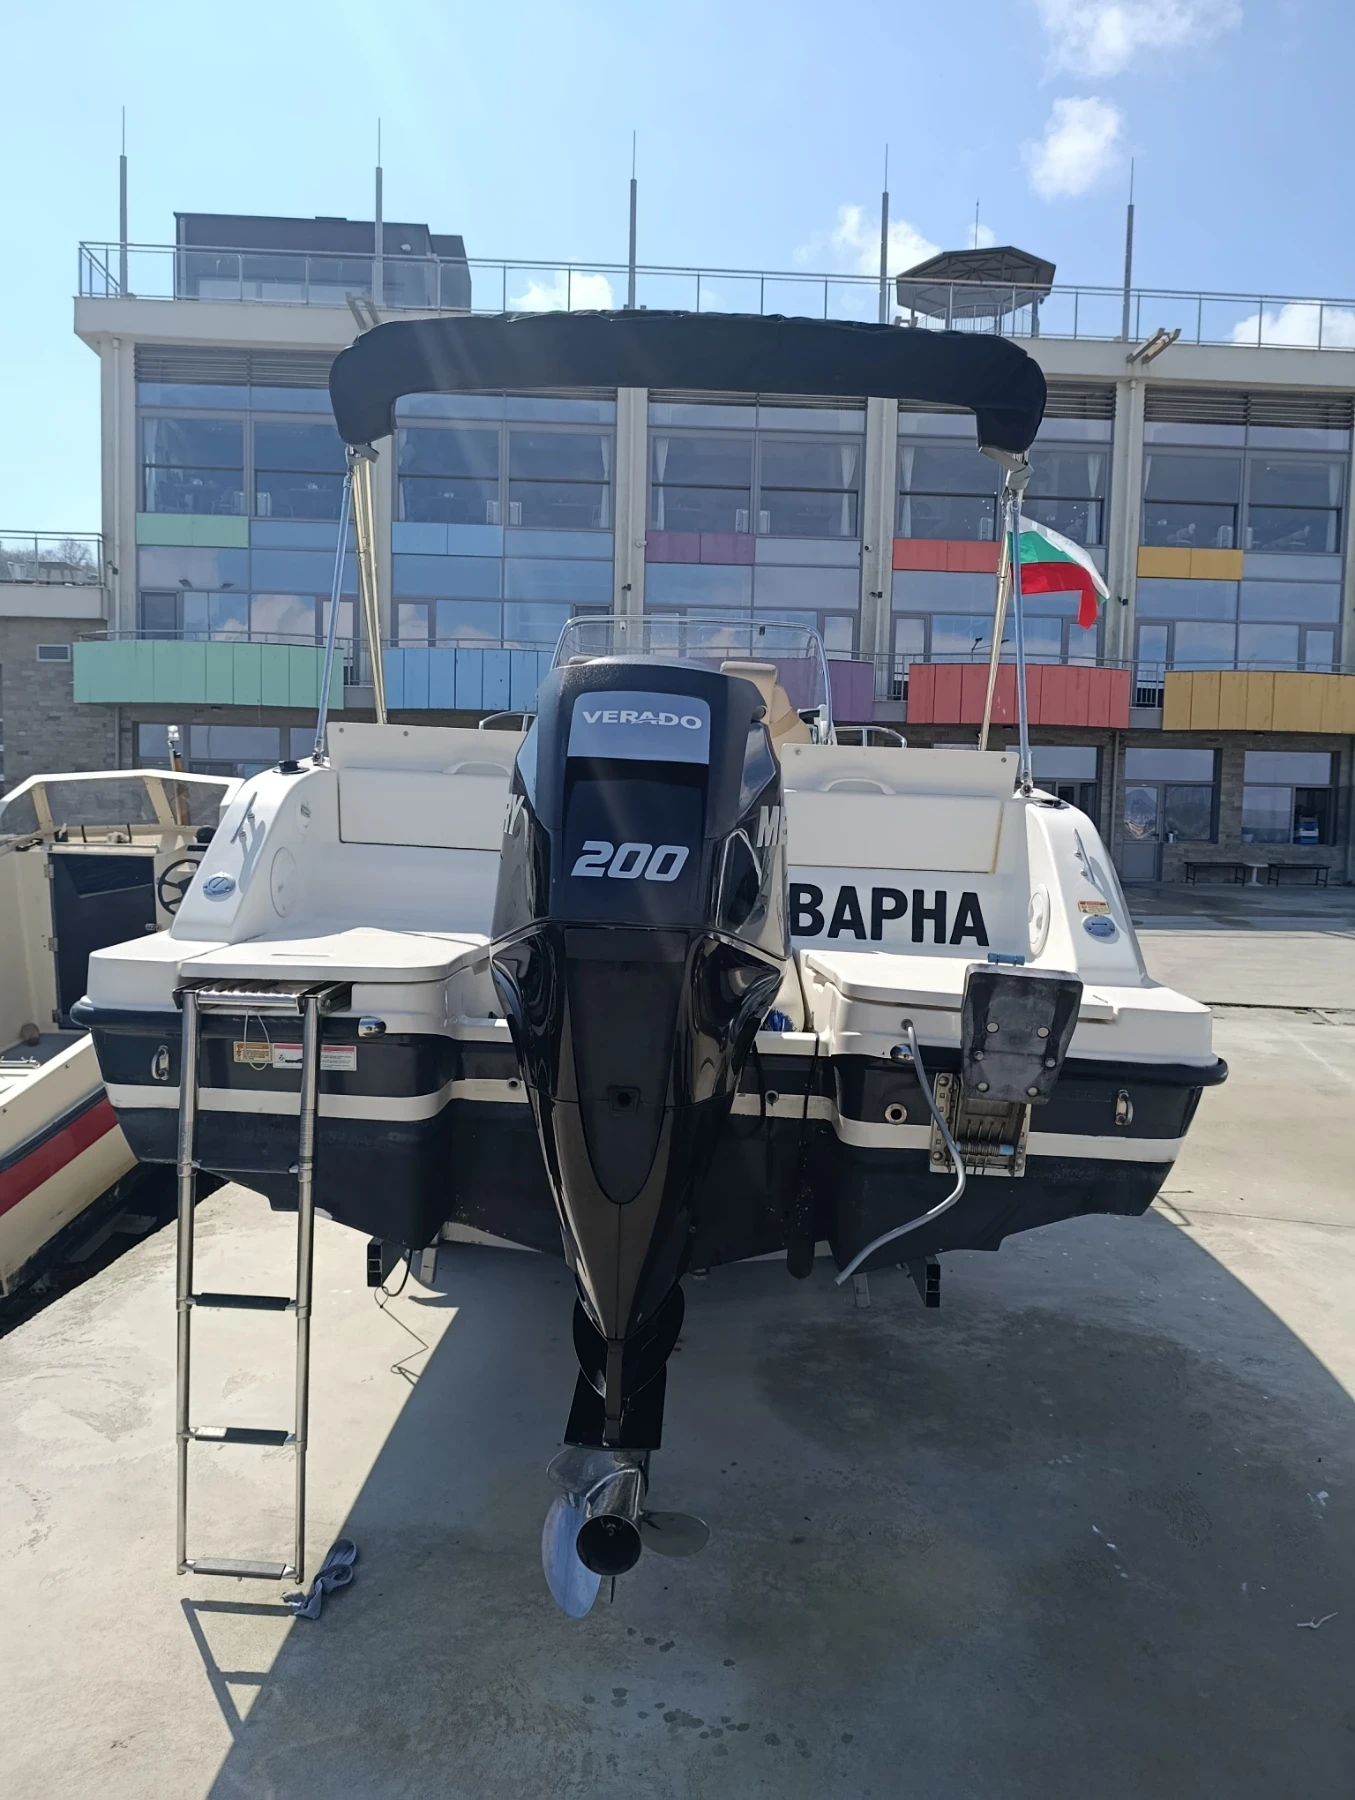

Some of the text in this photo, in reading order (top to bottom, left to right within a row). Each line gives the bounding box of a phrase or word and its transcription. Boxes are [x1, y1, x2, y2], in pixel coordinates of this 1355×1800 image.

[582, 710, 702, 730] VERADO
[570, 840, 690, 882] 200
[789, 882, 990, 947] ВАРНА
